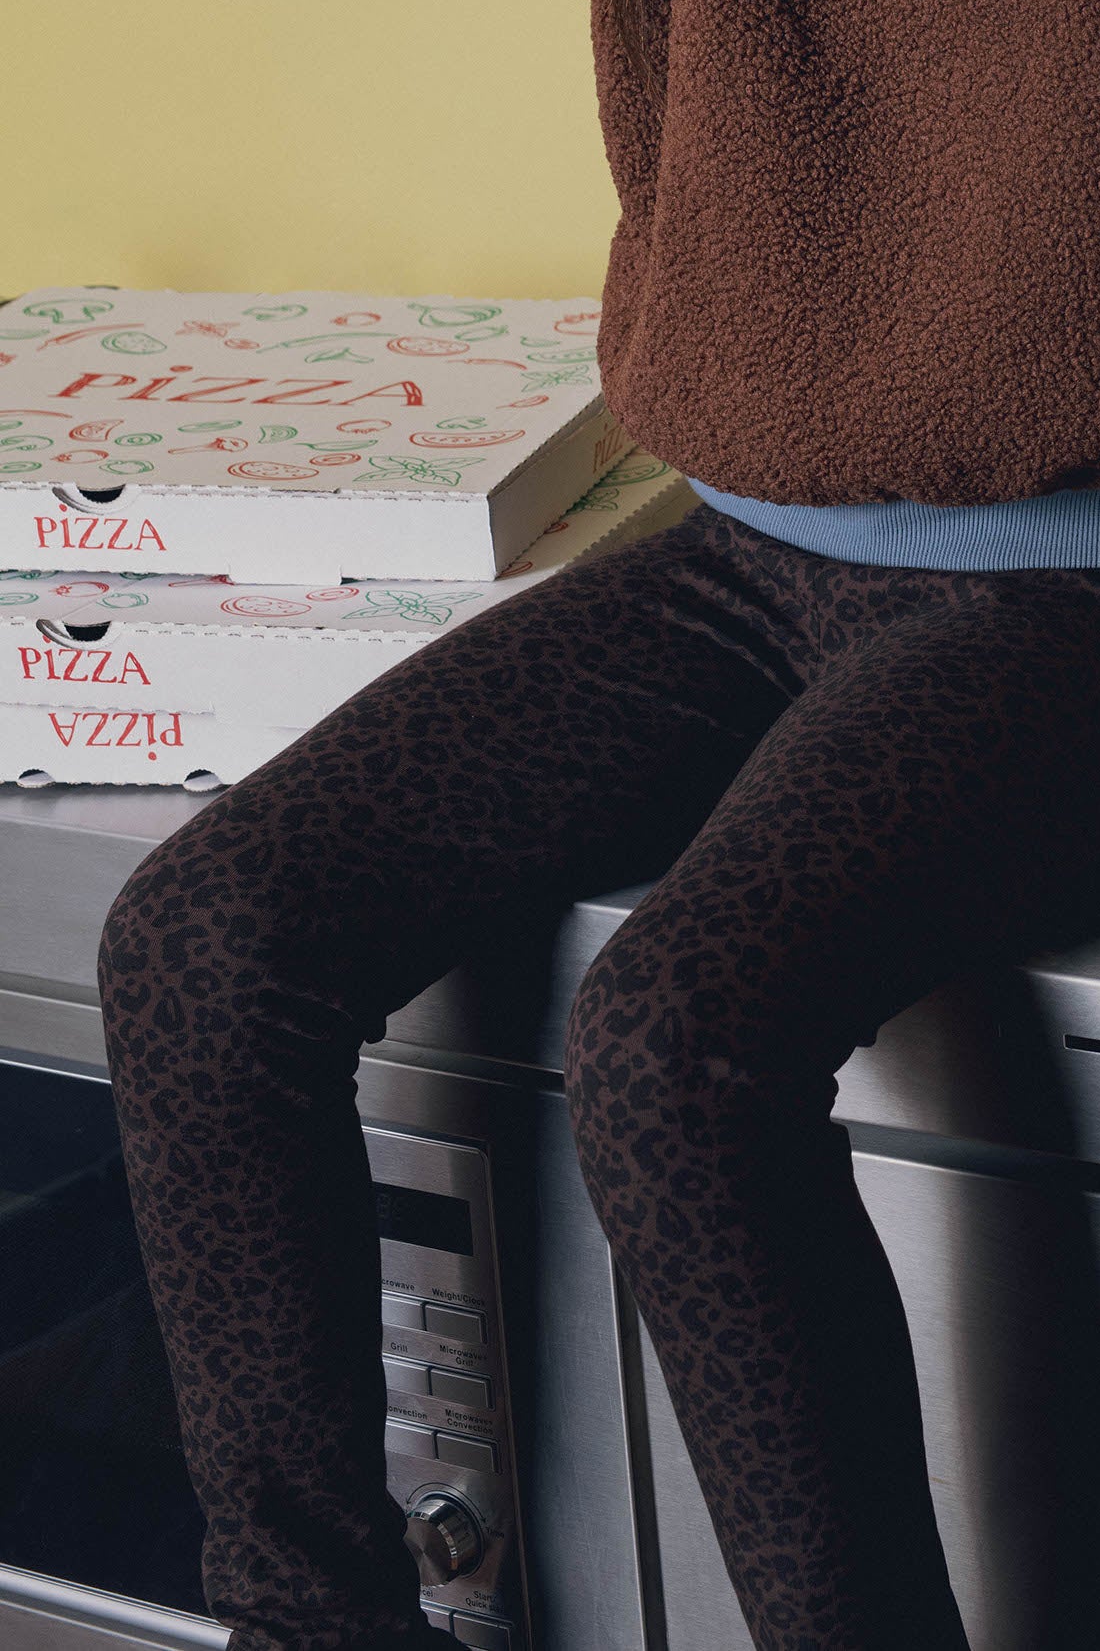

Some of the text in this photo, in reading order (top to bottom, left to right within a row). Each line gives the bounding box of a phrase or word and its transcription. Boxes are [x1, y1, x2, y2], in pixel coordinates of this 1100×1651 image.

[381, 1278, 416, 1291] crowave
[390, 1342, 409, 1353] Grill
[455, 1356, 474, 1367] Grill
[388, 1405, 429, 1421] onvection
[447, 1418, 494, 1436] Convection
[465, 1597, 487, 1609] Quick
